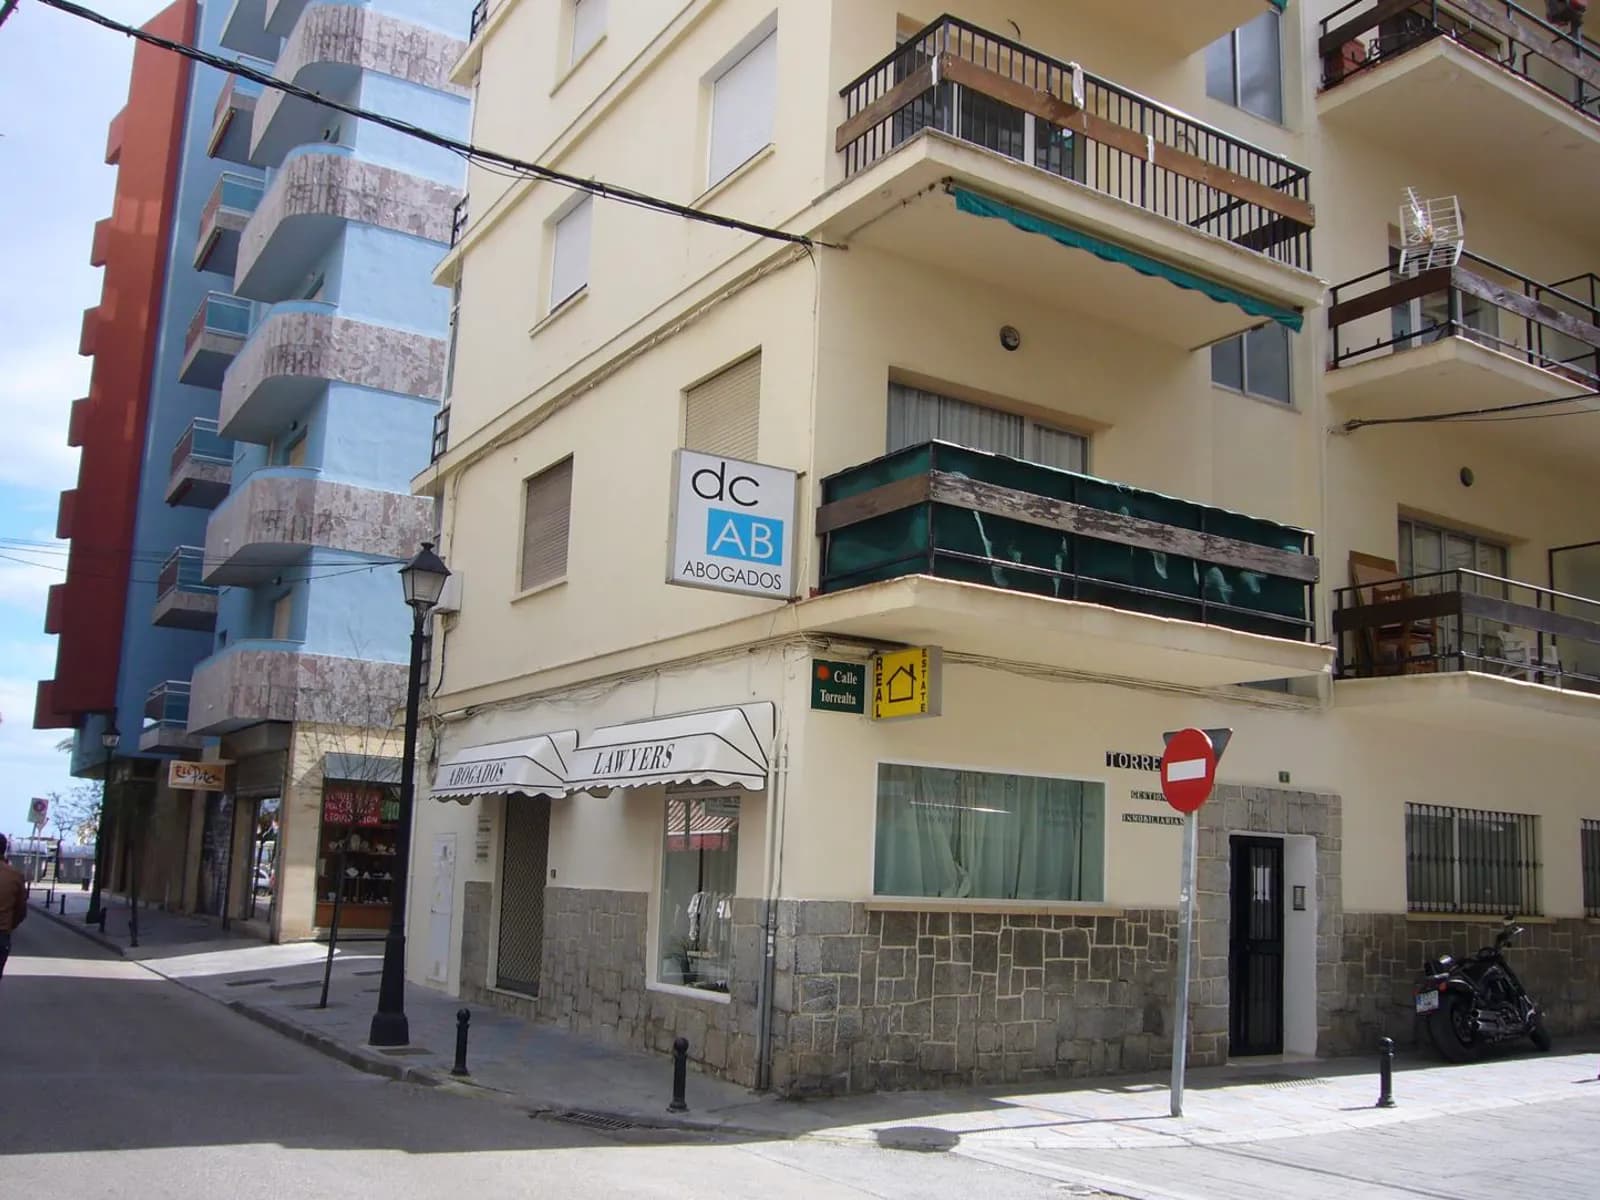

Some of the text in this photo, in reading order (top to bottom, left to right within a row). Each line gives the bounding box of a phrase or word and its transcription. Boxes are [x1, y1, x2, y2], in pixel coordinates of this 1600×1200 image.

[692, 462, 759, 506] dc
[712, 519, 774, 558] AB
[683, 560, 782, 590] ABOGADOS
[834, 670, 857, 685] Calle
[875, 657, 883, 718] REAL
[820, 689, 856, 705] Torrealta
[592, 743, 675, 774] LAWYERS
[449, 762, 506, 786] ABOGADOS
